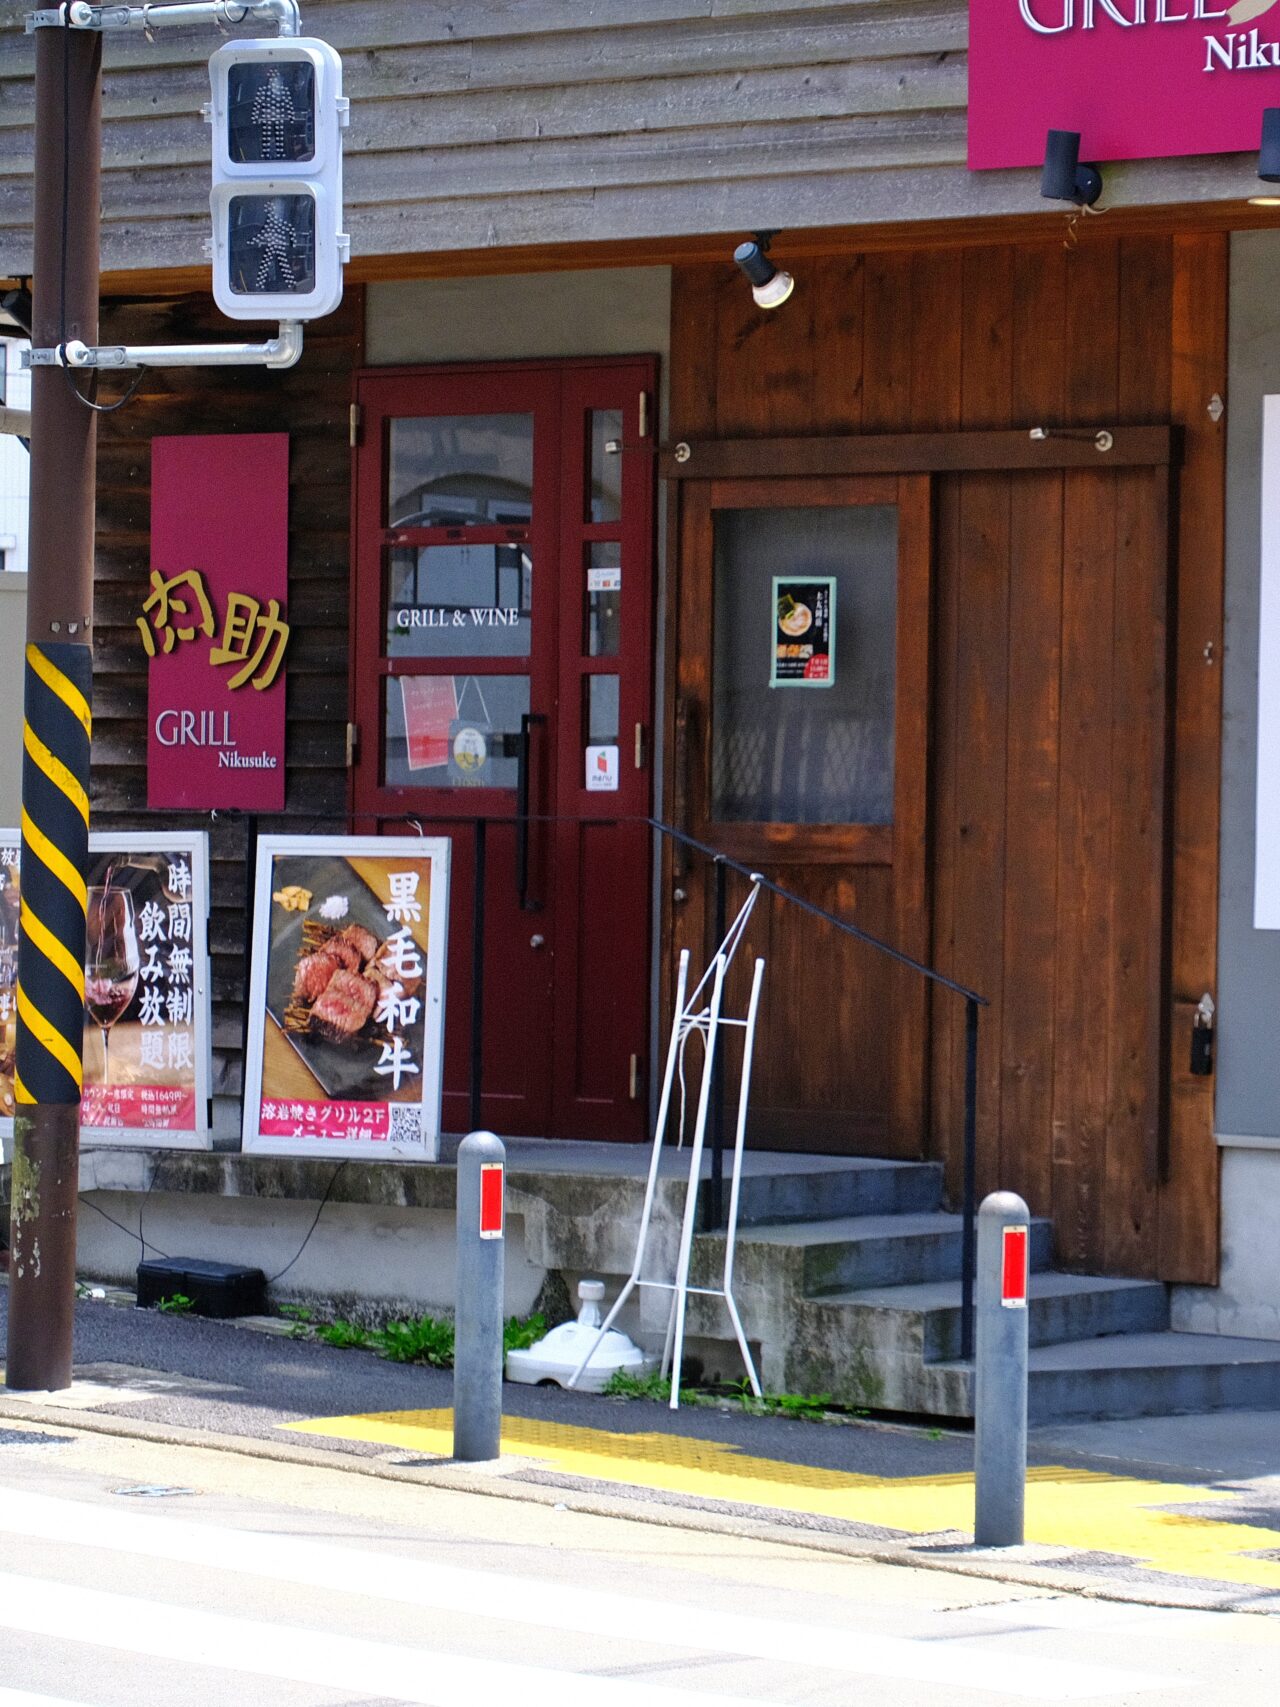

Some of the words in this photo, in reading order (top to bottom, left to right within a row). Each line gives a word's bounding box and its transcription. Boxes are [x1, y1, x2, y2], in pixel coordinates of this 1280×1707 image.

[396, 608, 449, 628] GRILL
[452, 609, 467, 627] &
[470, 607, 520, 627] WINE
[155, 709, 237, 746] GRILL
[217, 750, 277, 769] Nikusuke
[165, 857, 193, 1072] 時間無制限
[373, 871, 423, 1092] 黒毛和牛
[138, 901, 167, 1071] 飲み放題
[261, 1103, 385, 1124] 溶岩焼きグリル2F
